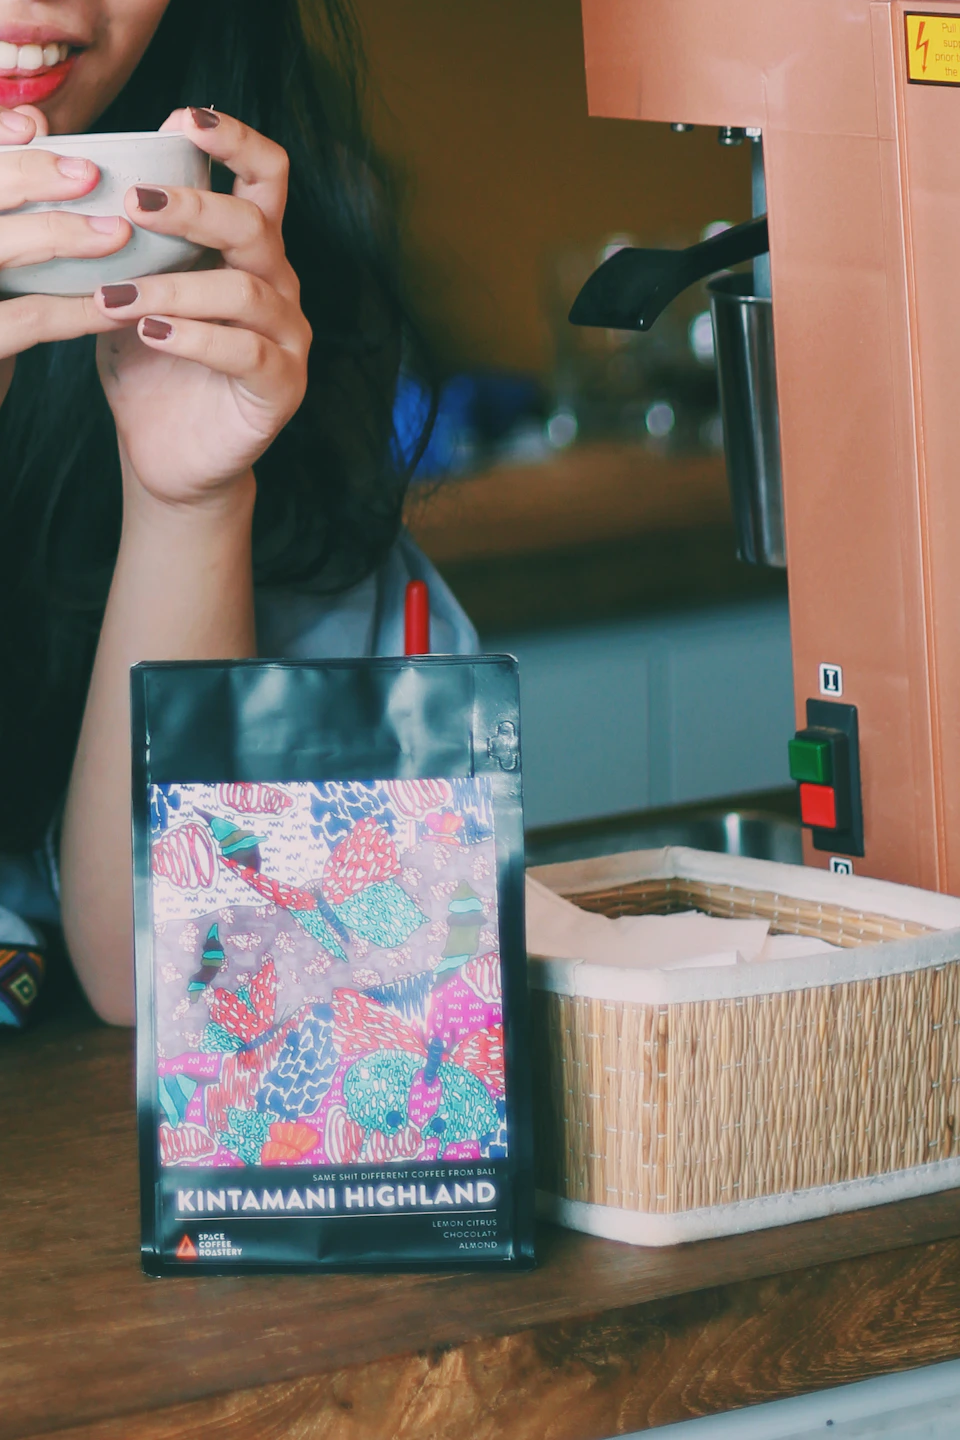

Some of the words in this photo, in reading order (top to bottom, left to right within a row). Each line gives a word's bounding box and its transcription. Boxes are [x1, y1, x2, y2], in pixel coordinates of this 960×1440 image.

[941, 22, 957, 33] Pull
[935, 52, 954, 63] prior
[945, 67, 958, 77] the
[312, 1173, 336, 1181] SAME
[339, 1172, 358, 1181] SHIT
[361, 1171, 408, 1180] DIFFERENT
[411, 1170, 446, 1179] COFFEE
[448, 1168, 474, 1177] FROM
[476, 1168, 496, 1176] BALI
[177, 1187, 336, 1212] KINTAMANI
[344, 1181, 496, 1209] HIGHLAND
[432, 1220, 464, 1228] LEMON
[466, 1219, 497, 1227] CITRUS
[198, 1233, 225, 1241] SPACE
[443, 1230, 497, 1239] CHOCOLATY
[198, 1240, 232, 1248] COFFEE
[458, 1241, 497, 1250] ALMOND
[198, 1248, 243, 1257] ROASTERY
